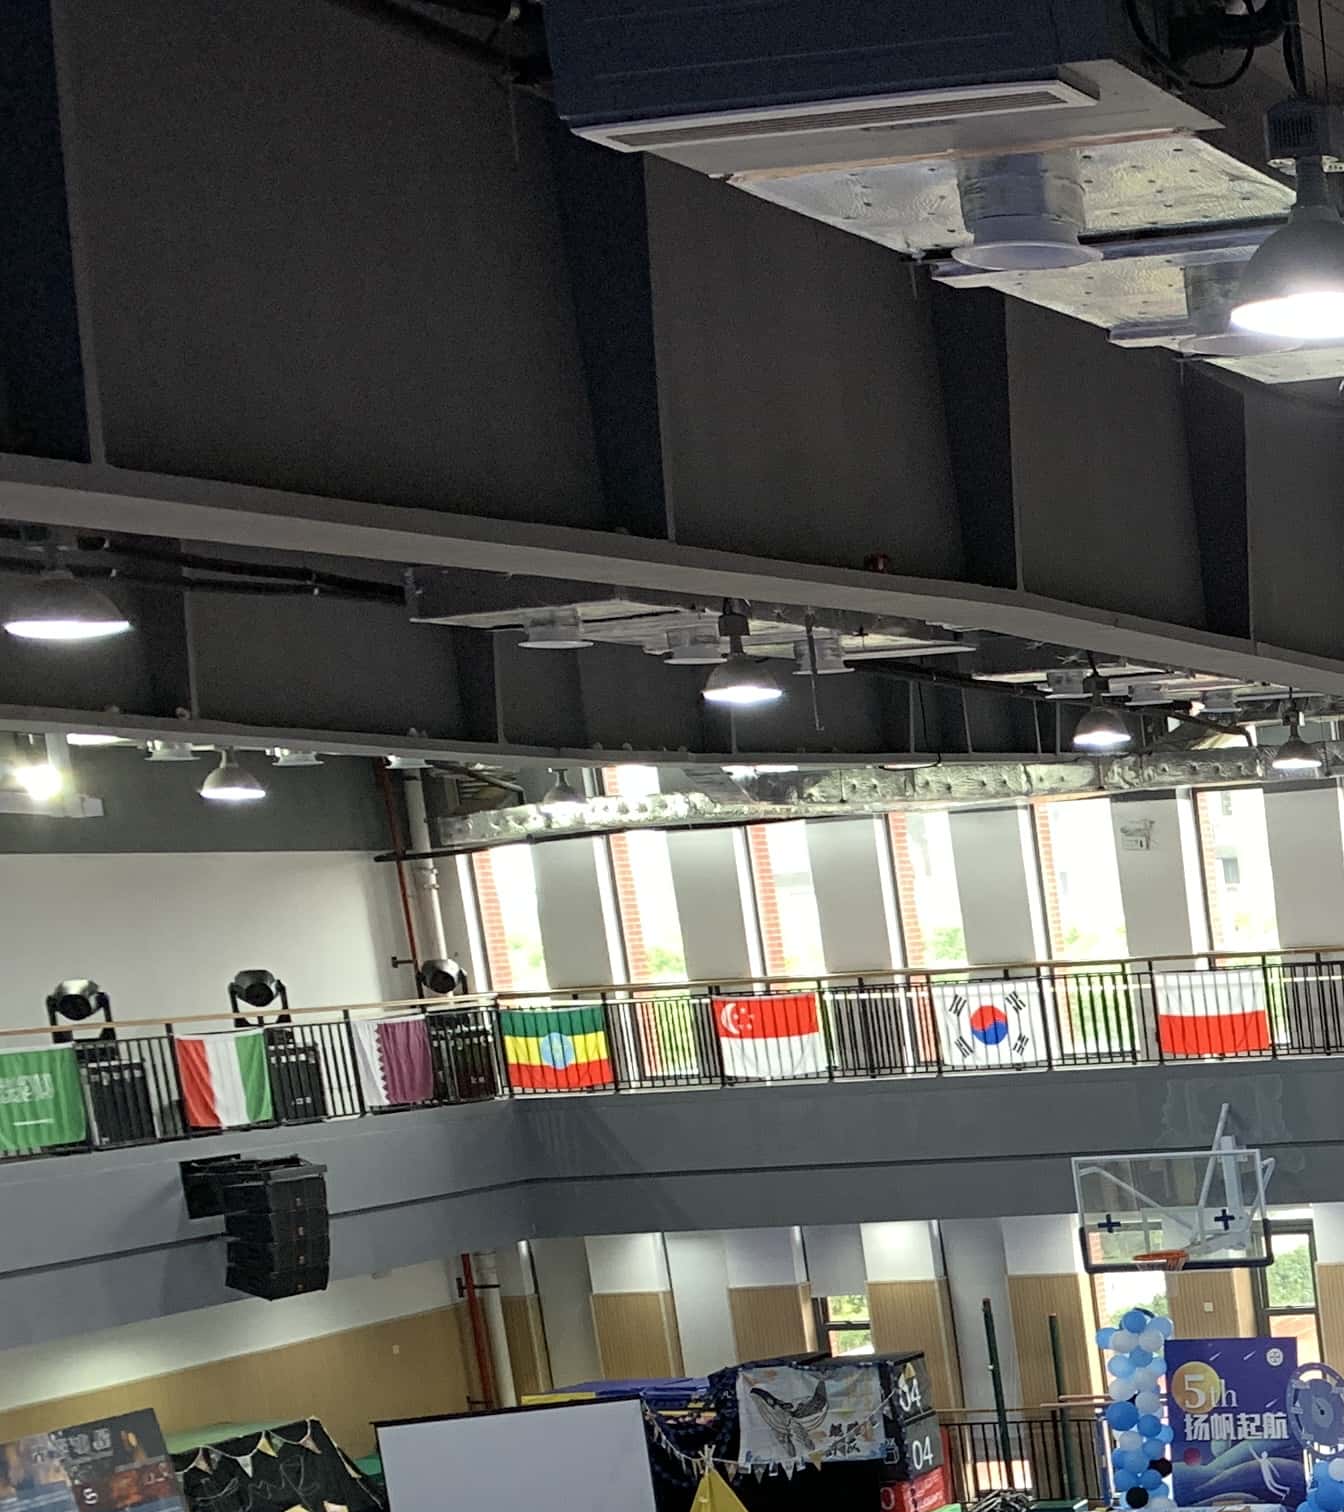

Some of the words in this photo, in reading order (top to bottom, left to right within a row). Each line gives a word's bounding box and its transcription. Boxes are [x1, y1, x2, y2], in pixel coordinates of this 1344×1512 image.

[1183, 1373, 1238, 1409] 5th
[1183, 1411, 1290, 1441] 扬帆起航
[911, 1436, 934, 1470] 04
